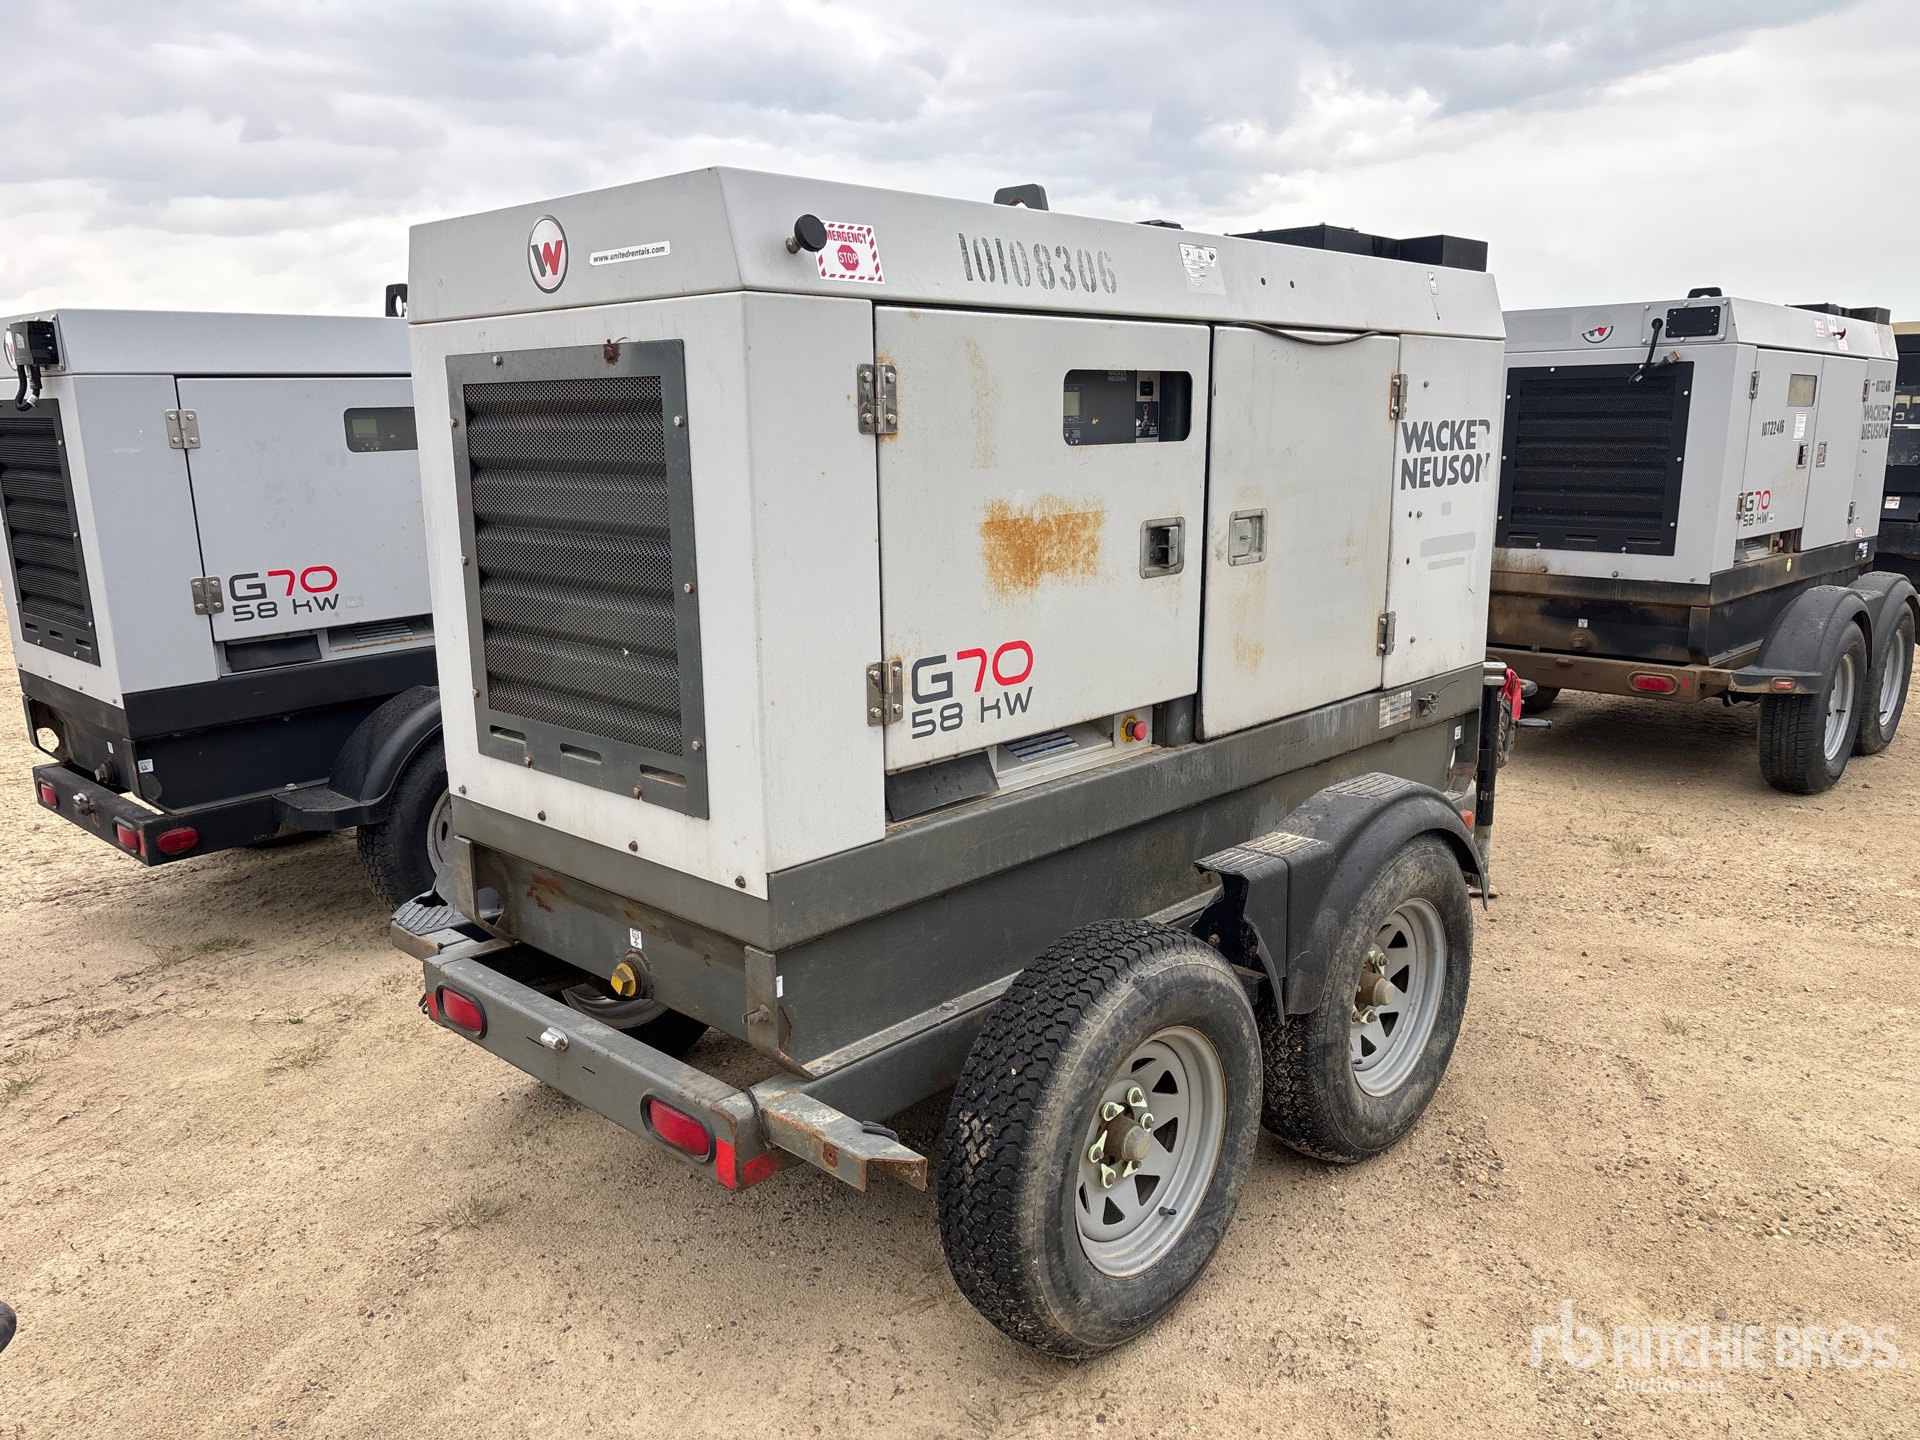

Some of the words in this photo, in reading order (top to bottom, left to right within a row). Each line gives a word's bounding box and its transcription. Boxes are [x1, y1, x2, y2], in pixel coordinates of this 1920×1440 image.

[826, 230, 867, 244] MERGENCY
[593, 245, 666, 262] www.unitedrentals.com
[838, 252, 858, 264] STOP
[1744, 490, 1771, 512] G70
[1742, 513, 1755, 527] 58
[229, 565, 338, 602] G70
[232, 601, 279, 622] 58
[911, 640, 1034, 705] G70
[911, 702, 963, 740] 58
